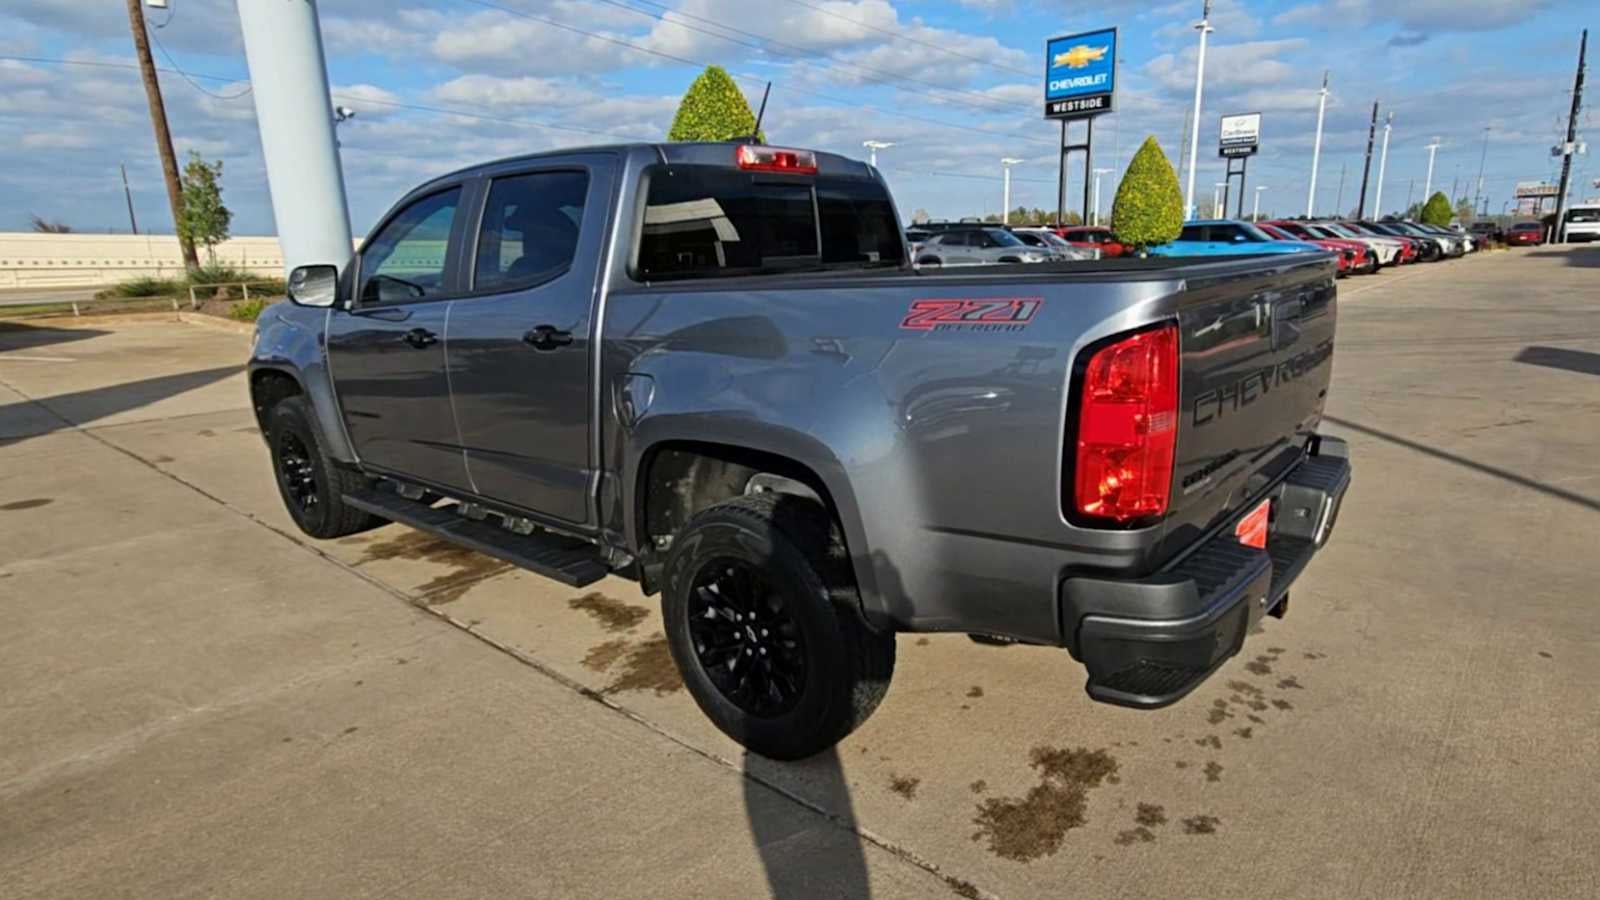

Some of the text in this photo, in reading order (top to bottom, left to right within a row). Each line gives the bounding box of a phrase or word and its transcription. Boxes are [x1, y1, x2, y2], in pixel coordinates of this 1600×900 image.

[1049, 73, 1108, 91] CHEVROLET
[1053, 97, 1103, 113] WESTSIDE
[899, 297, 1045, 331] Z71
